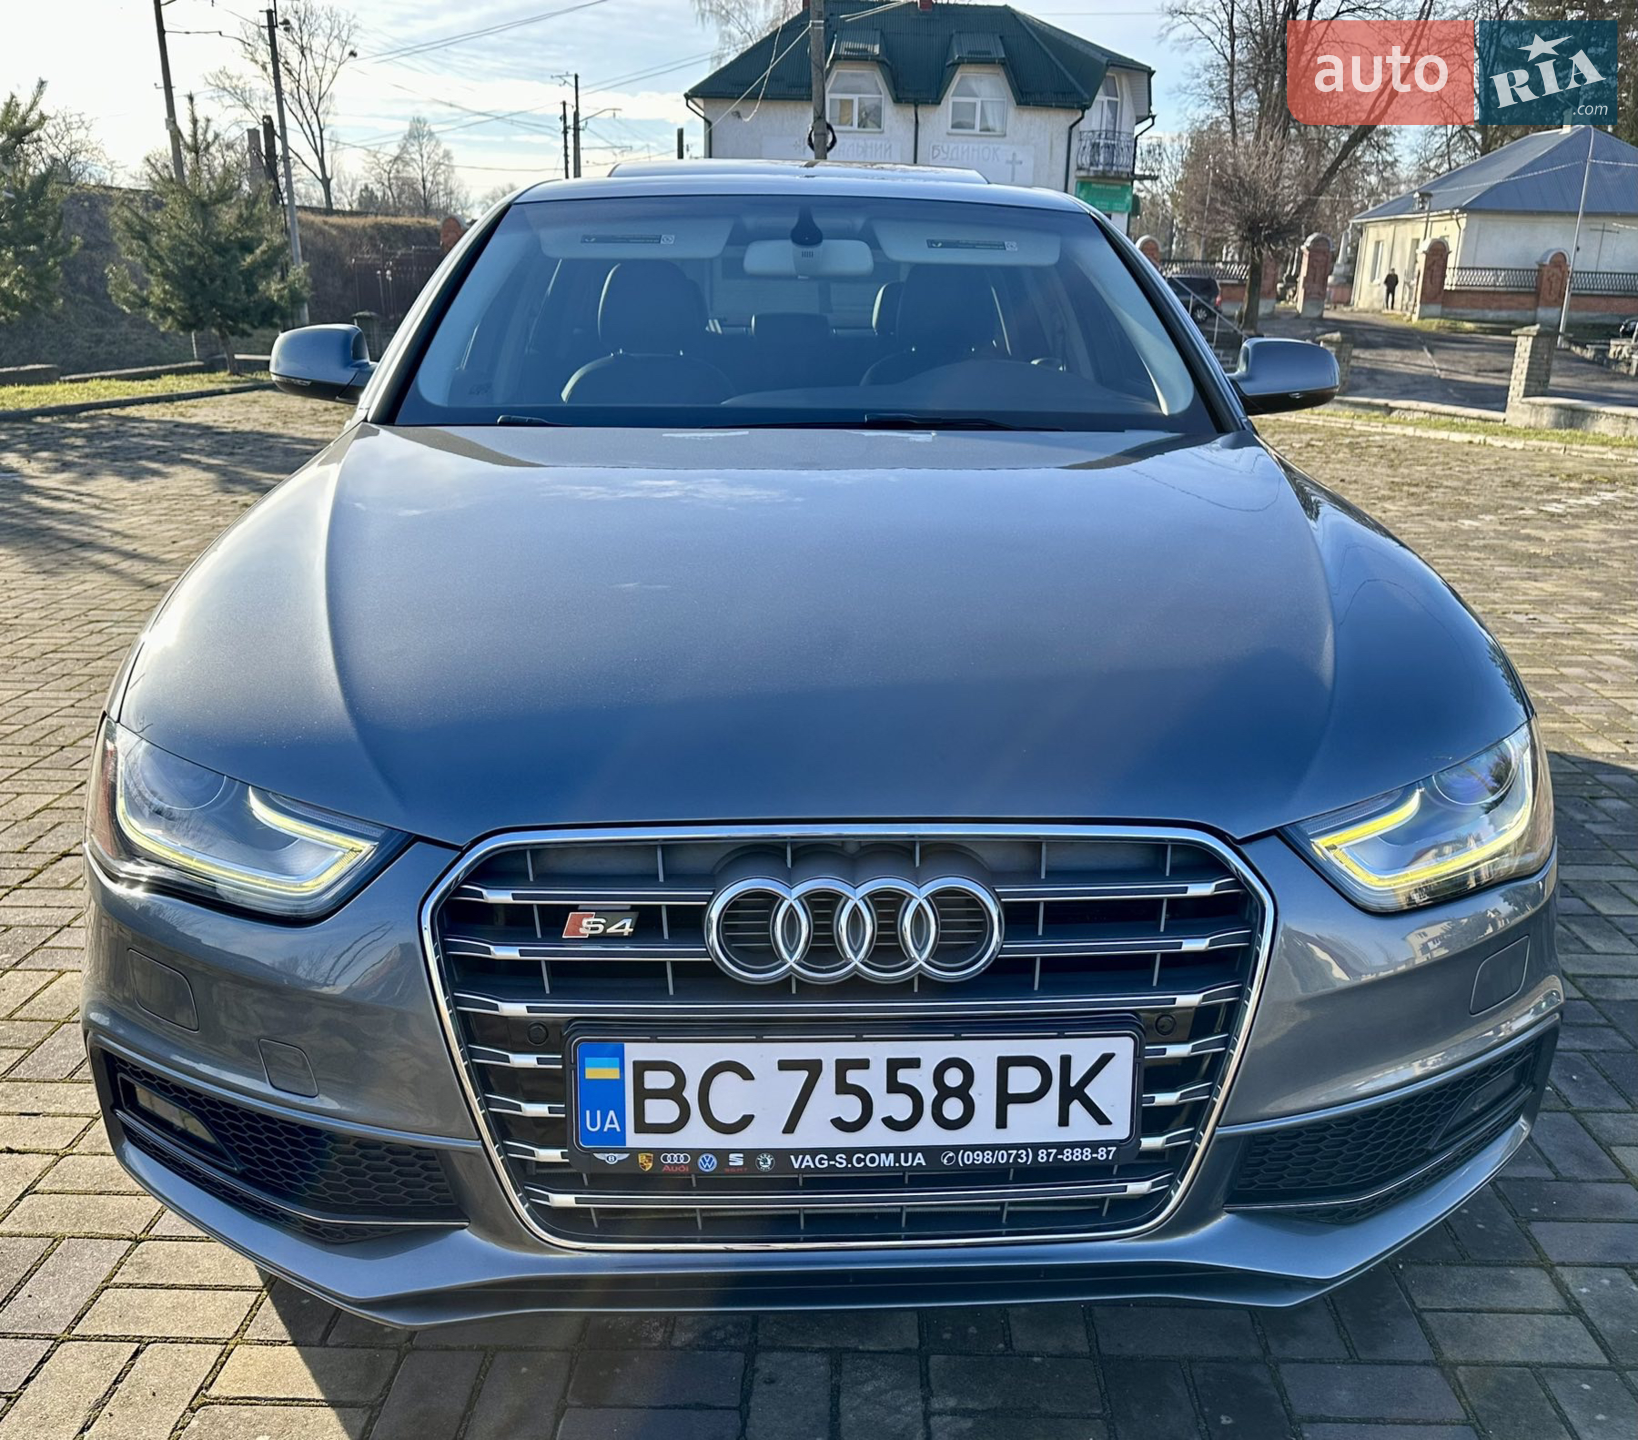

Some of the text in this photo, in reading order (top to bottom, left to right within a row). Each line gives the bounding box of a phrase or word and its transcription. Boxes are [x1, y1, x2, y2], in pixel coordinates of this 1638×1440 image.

[931, 144, 1001, 162] БУДИНОК
[579, 918, 634, 936] S4
[632, 1053, 1116, 1134] BC 7558 PK
[585, 1110, 621, 1132] UA
[790, 1152, 926, 1168] VAG-S.COM.UA
[958, 1147, 1117, 1166] (098/073) 87-888-87
